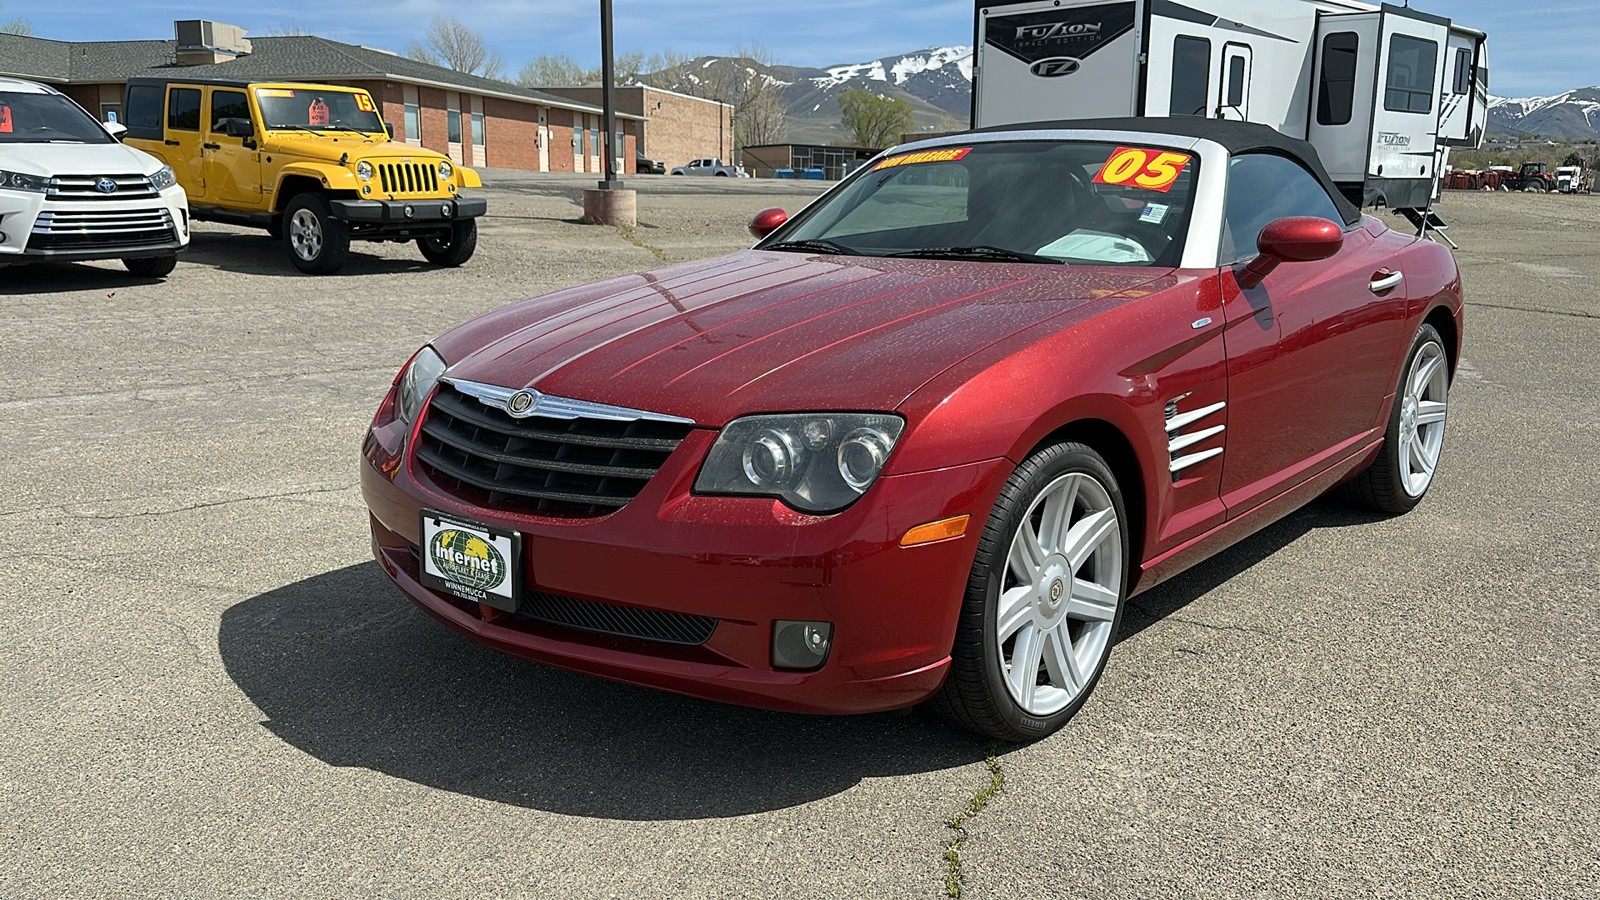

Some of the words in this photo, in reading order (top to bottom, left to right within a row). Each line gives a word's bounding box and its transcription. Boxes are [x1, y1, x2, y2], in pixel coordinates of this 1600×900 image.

[1013, 40, 1049, 48] IMPACT
[1057, 36, 1102, 44] EDITION
[1037, 61, 1077, 76] FZ
[354, 94, 374, 112] 15
[1102, 149, 1188, 188] 05
[435, 540, 498, 574] Internet
[444, 580, 487, 599] WINNEMUCCA
